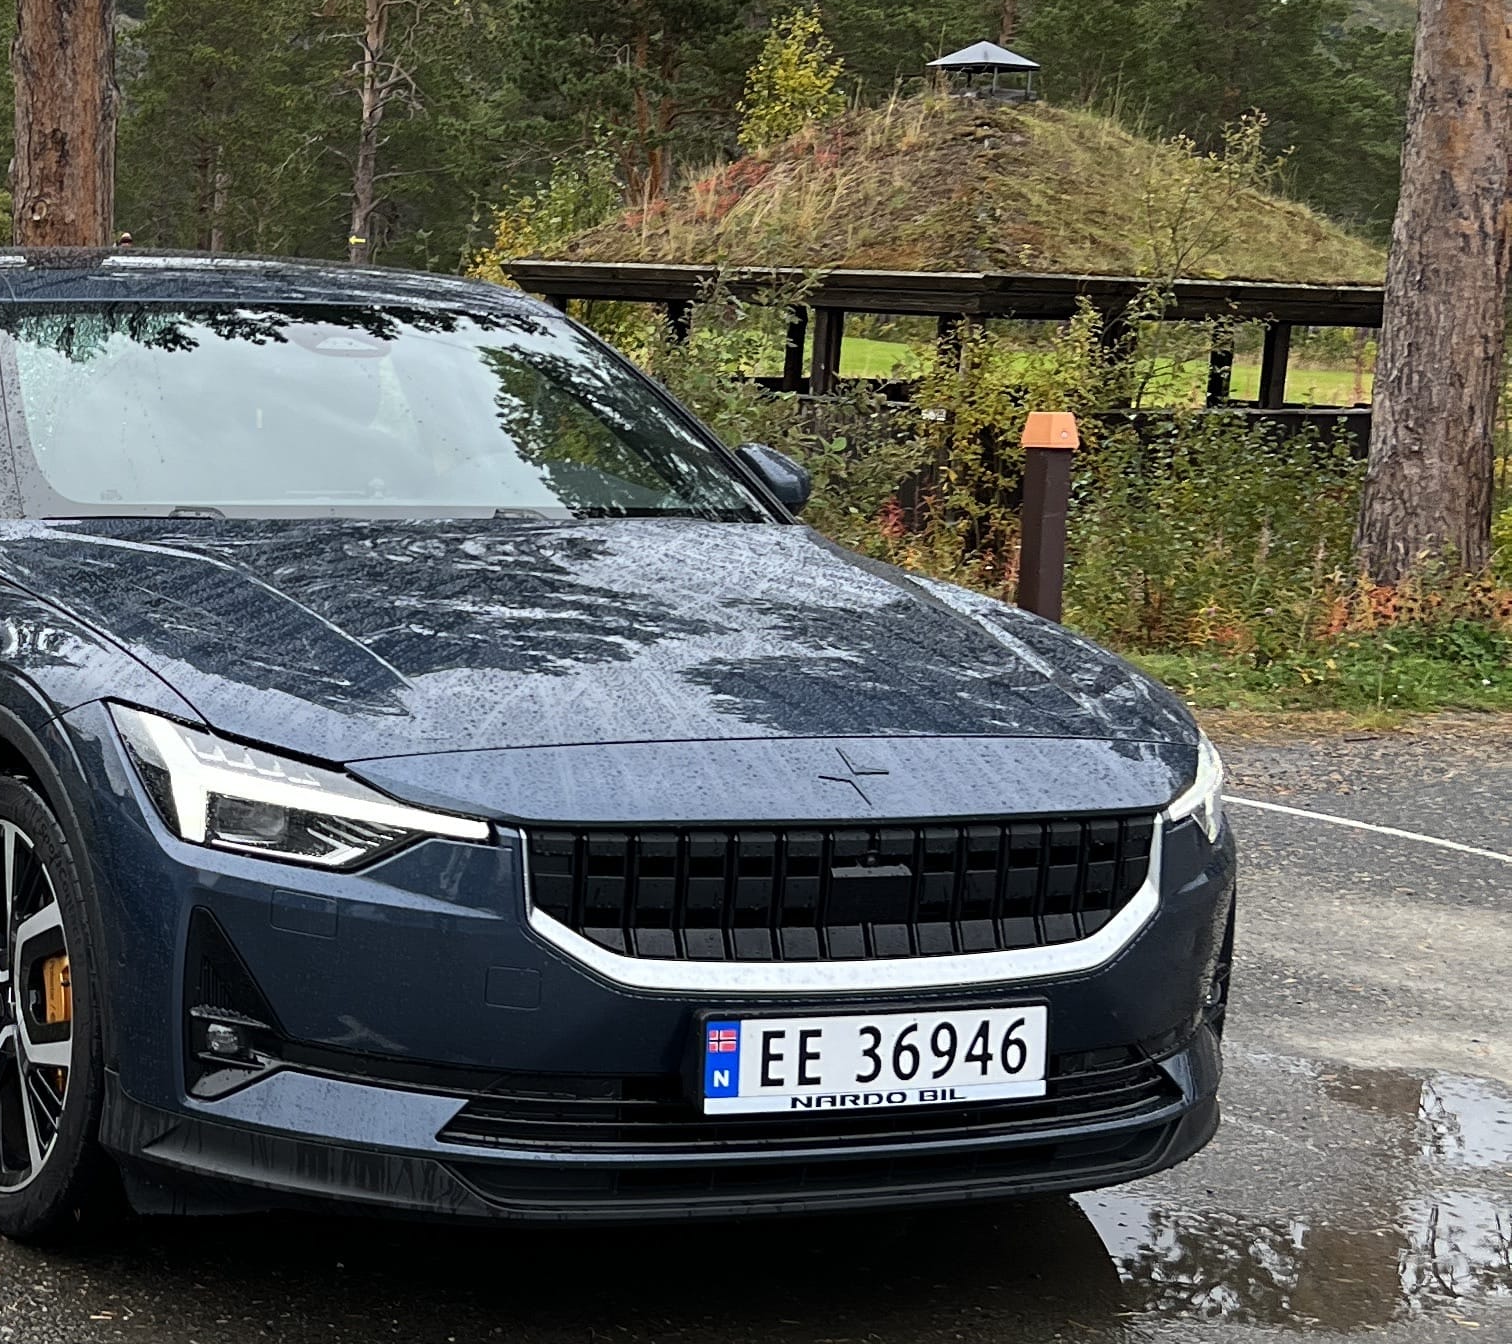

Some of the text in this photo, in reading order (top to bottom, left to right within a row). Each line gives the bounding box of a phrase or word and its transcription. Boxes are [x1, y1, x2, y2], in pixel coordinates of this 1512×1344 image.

[759, 1017, 1028, 1087] EE 36946
[713, 1070, 730, 1088] N
[790, 1088, 967, 1110] NARDO BIL
